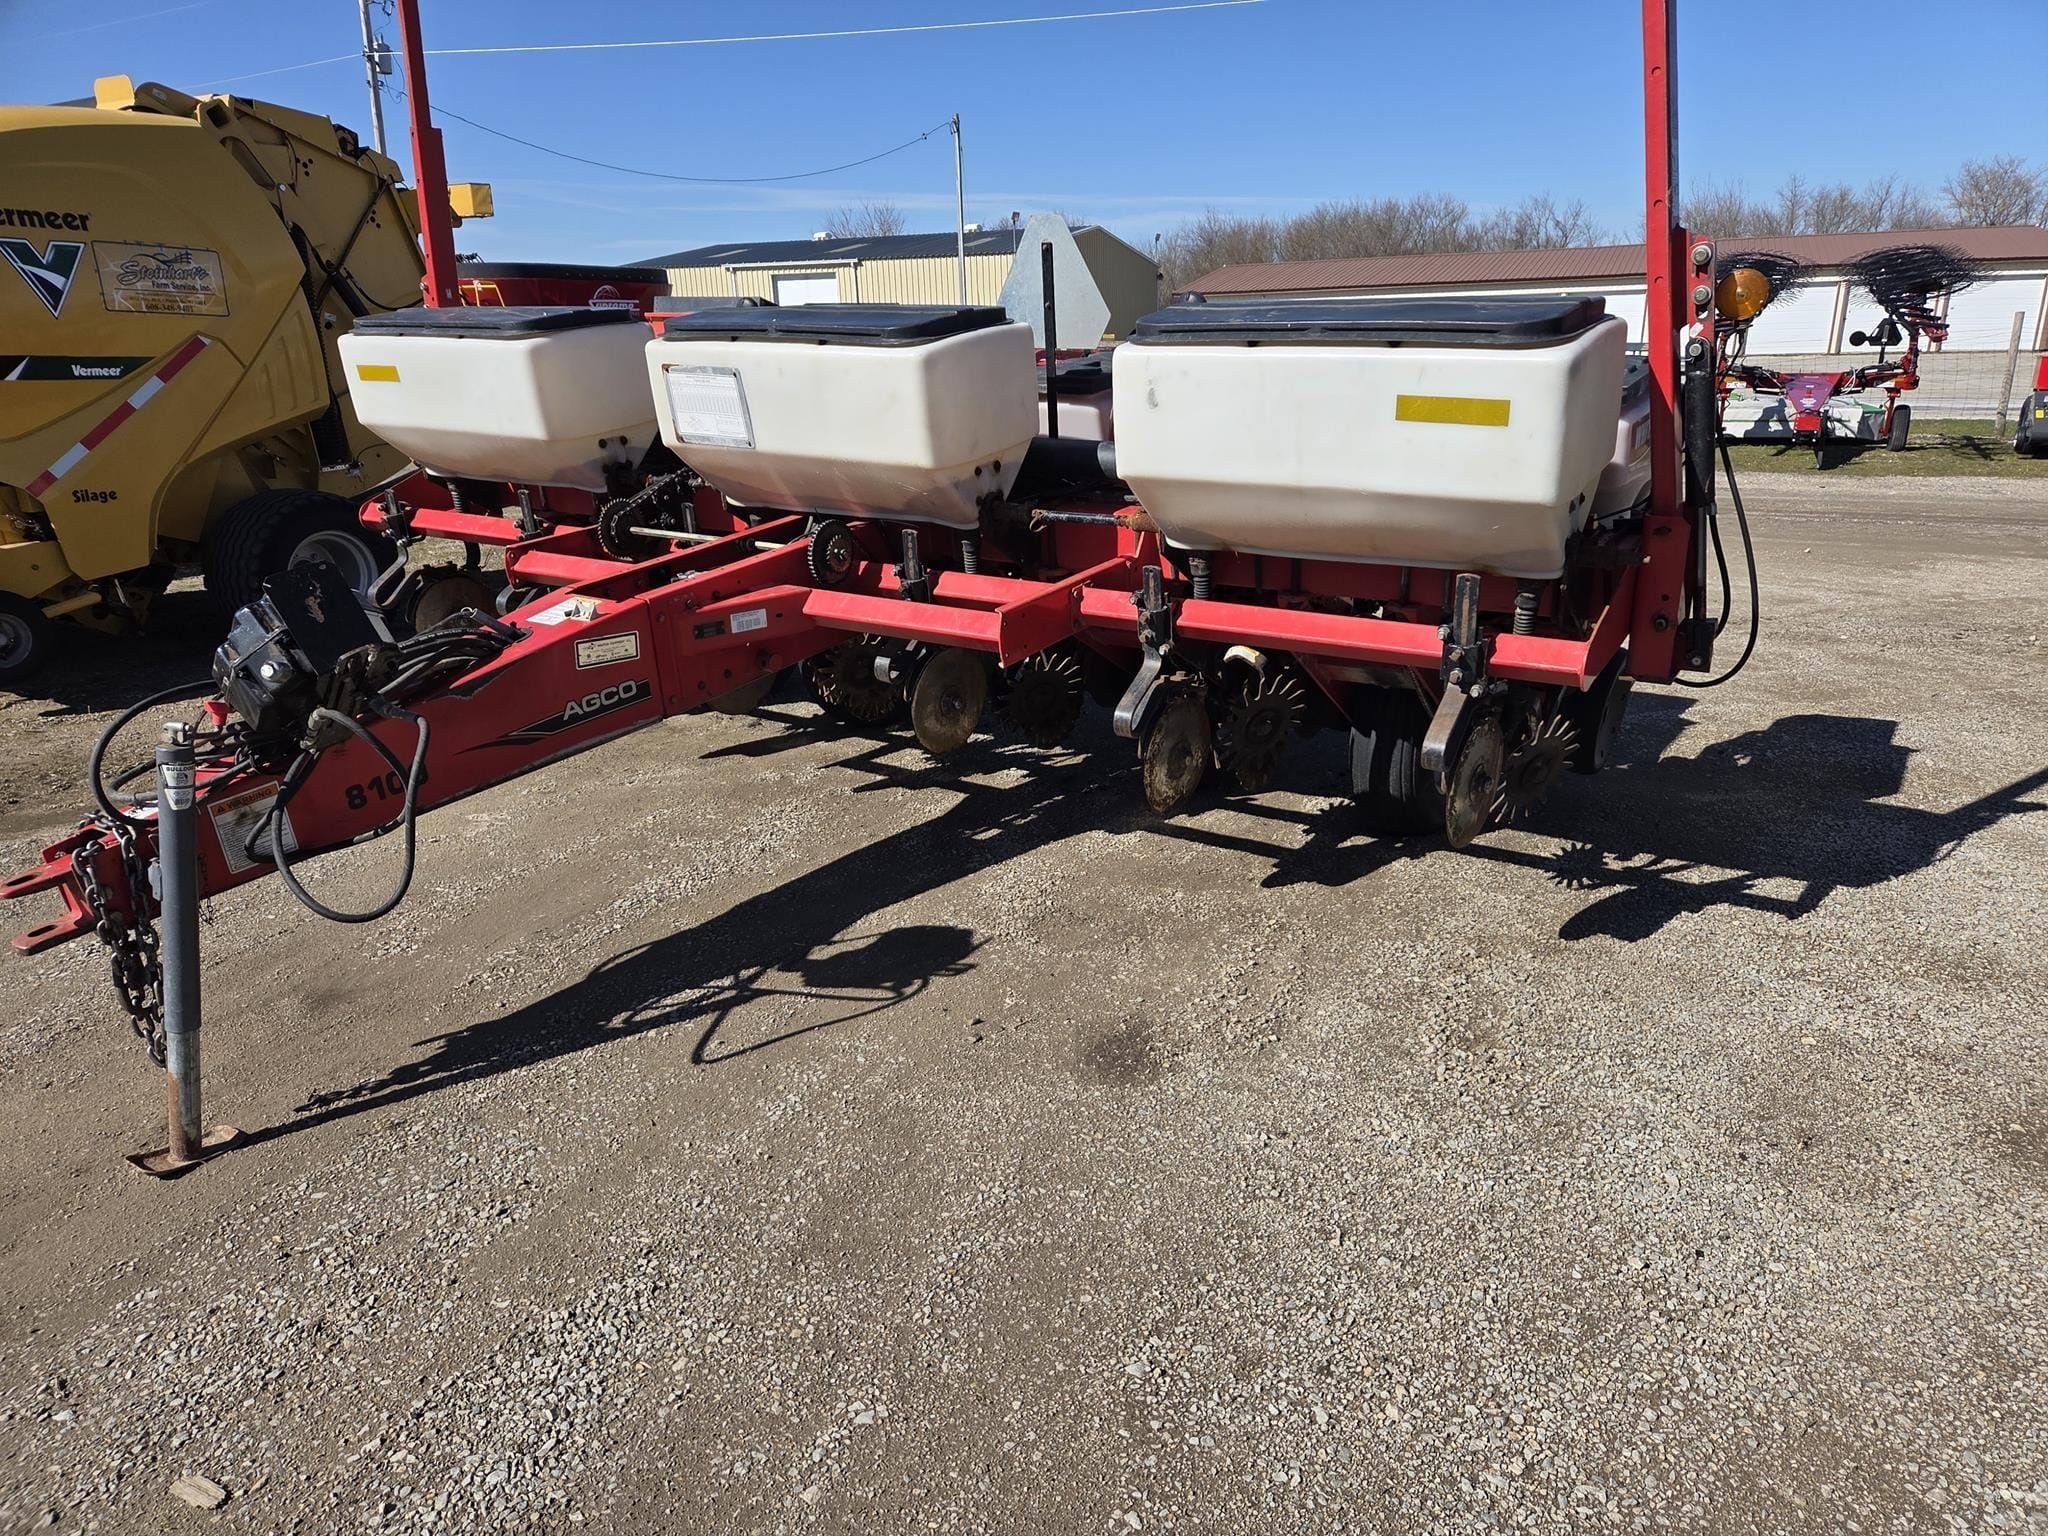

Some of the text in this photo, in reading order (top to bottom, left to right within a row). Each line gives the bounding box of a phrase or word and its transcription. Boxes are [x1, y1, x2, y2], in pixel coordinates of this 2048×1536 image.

[152, 280, 170, 289] Farm
[171, 281, 199, 292] Service,
[71, 364, 121, 376] Vermeer
[72, 488, 118, 503] Silage
[563, 680, 637, 721] AGCO
[224, 788, 273, 809] WRNING
